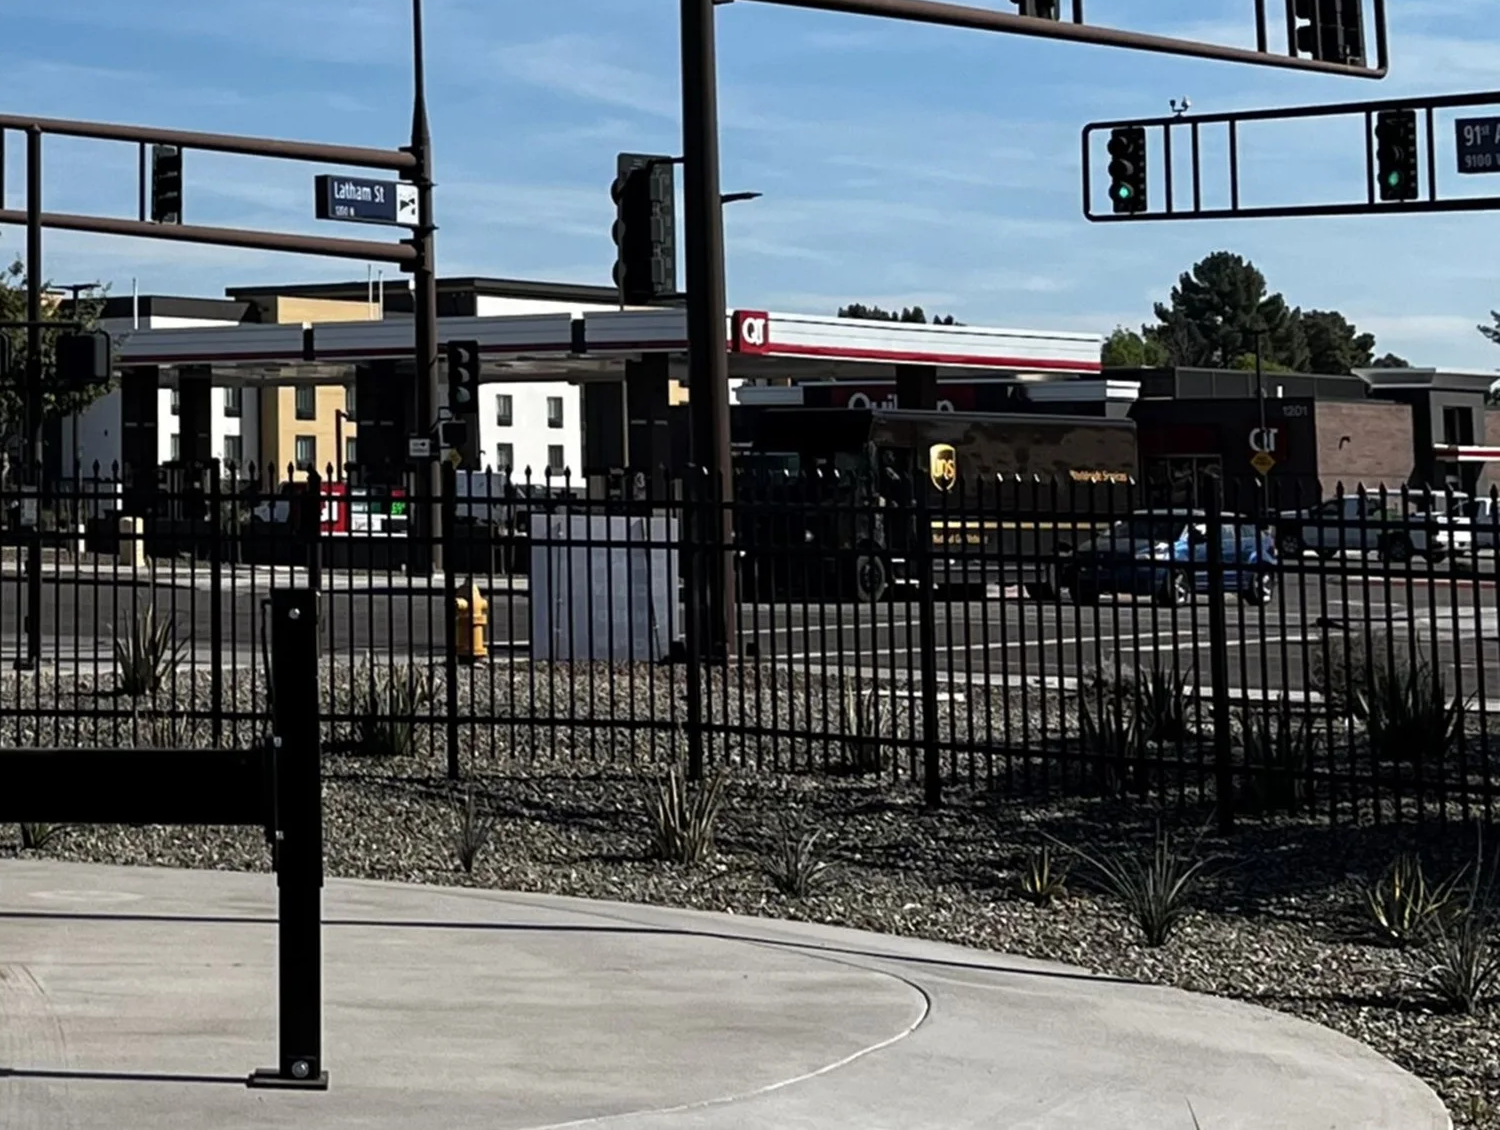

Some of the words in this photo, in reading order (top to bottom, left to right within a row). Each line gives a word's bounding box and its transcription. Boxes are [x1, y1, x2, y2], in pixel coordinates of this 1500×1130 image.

[333, 181, 371, 202] Latham
[373, 185, 385, 202] St
[1283, 405, 1308, 417] 1201
